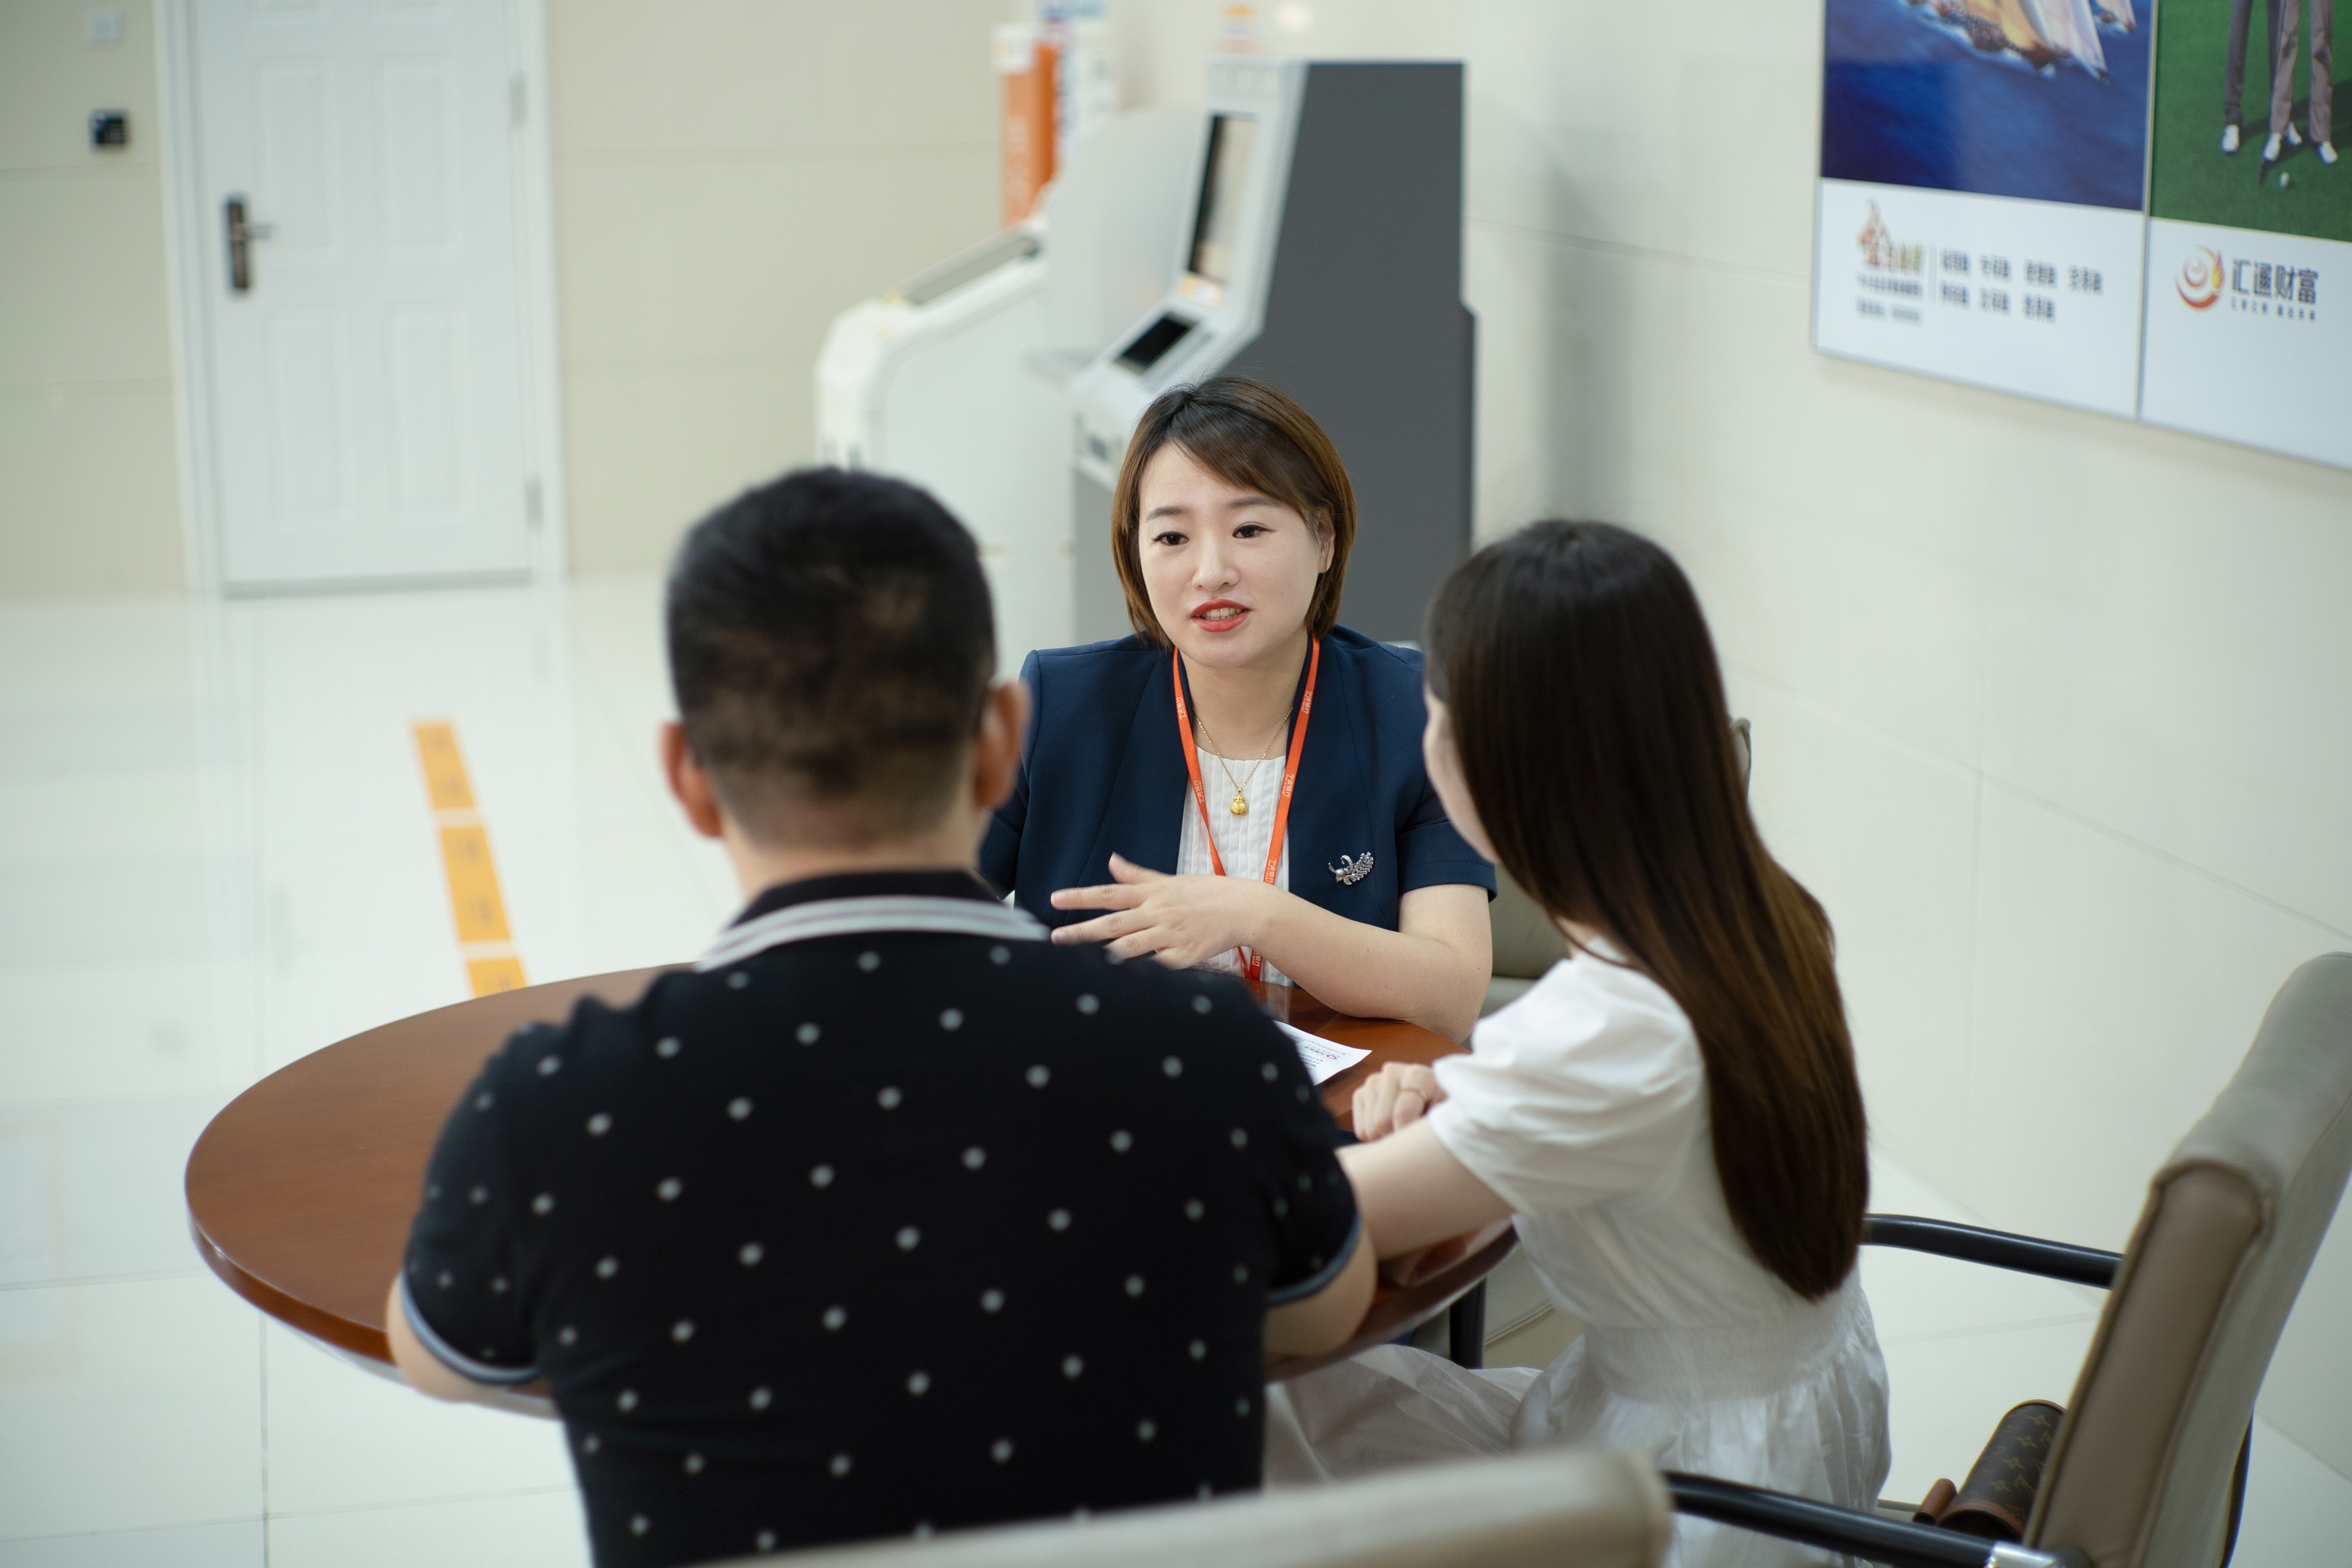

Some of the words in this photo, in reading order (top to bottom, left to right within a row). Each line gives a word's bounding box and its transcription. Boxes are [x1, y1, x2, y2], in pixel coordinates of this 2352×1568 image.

[2231, 257, 2318, 304] 汇通财富
[1176, 697, 1185, 720] 宁波银行
[1303, 691, 1311, 713] 宁波银行
[1193, 780, 1203, 803] 宁波银行
[1284, 774, 1294, 798] 宁波银行
[1267, 859, 1277, 883] 宁波银行
